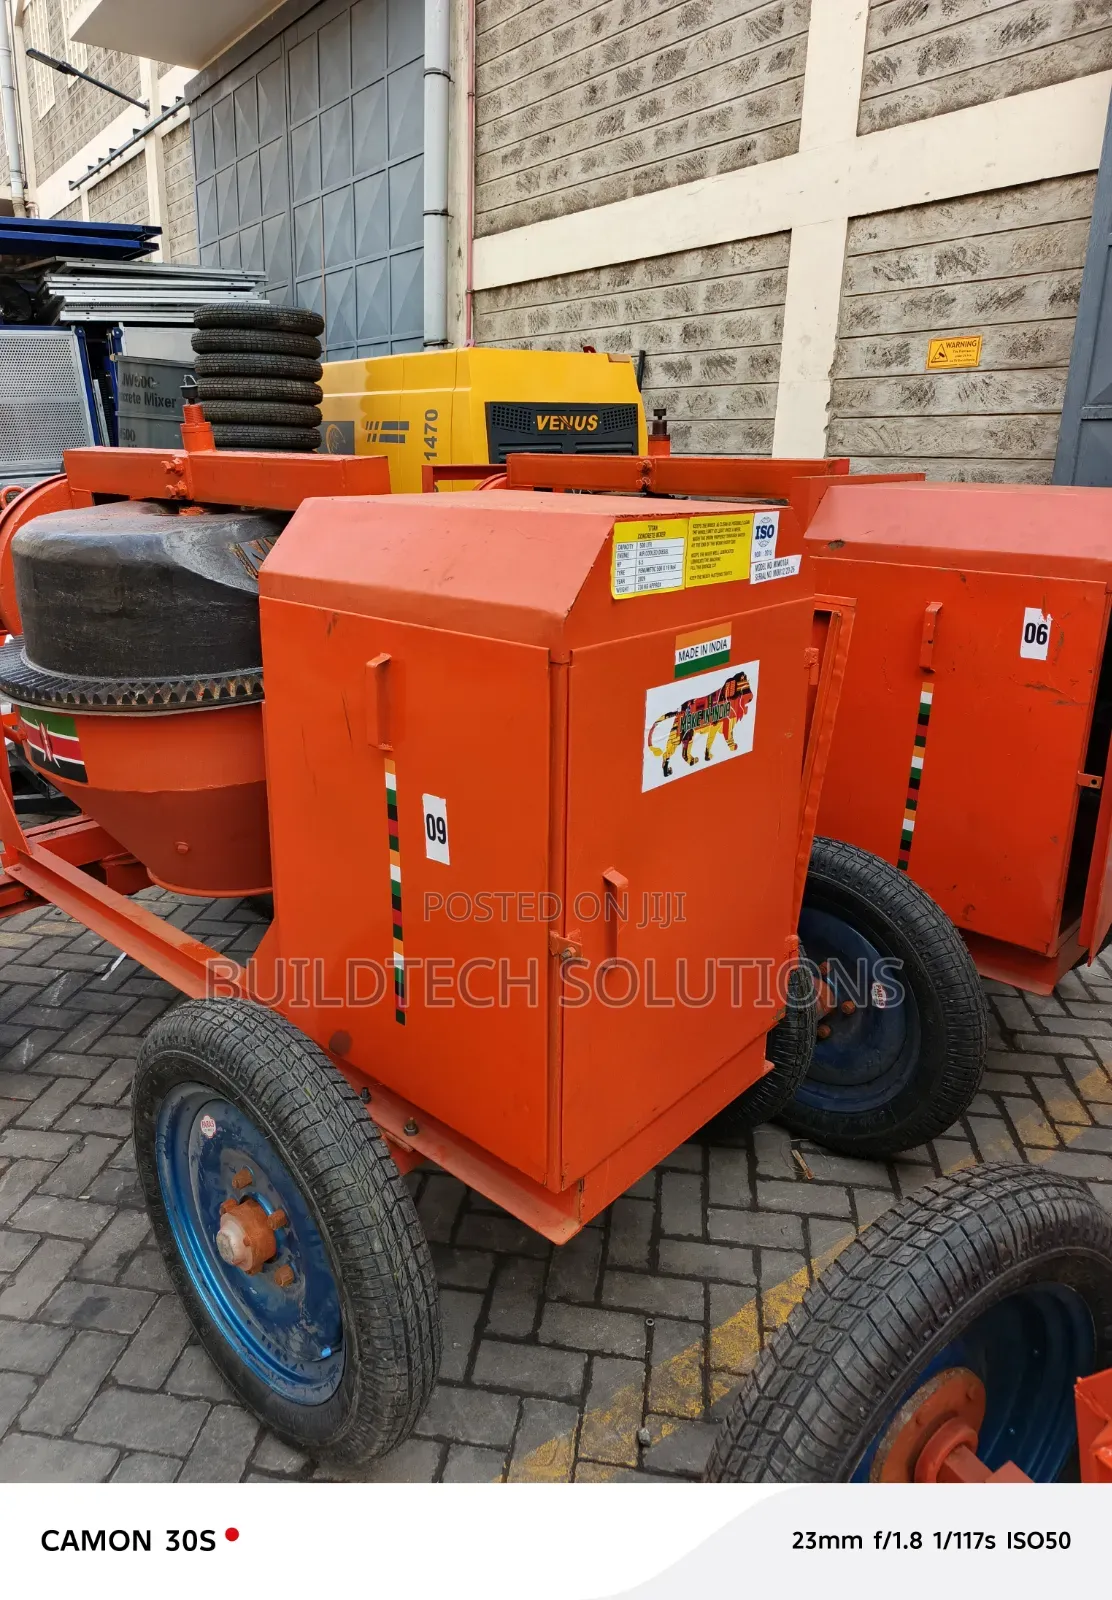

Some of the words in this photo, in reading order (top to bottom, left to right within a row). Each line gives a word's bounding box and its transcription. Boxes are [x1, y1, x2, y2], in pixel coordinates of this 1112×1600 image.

[945, 340, 977, 348] WARNING
[144, 392, 177, 408] Mixer
[536, 414, 599, 431] VENUS
[424, 409, 438, 461] 1470
[755, 524, 774, 540] ISO
[617, 543, 633, 551] CAPACITY
[1024, 622, 1048, 645] 06
[678, 645, 699, 663] MADE
[700, 644, 708, 656] IN
[709, 638, 728, 653] INDIA
[680, 710, 701, 733] MAKE
[711, 702, 731, 723] INDIA
[426, 813, 446, 844] 09
